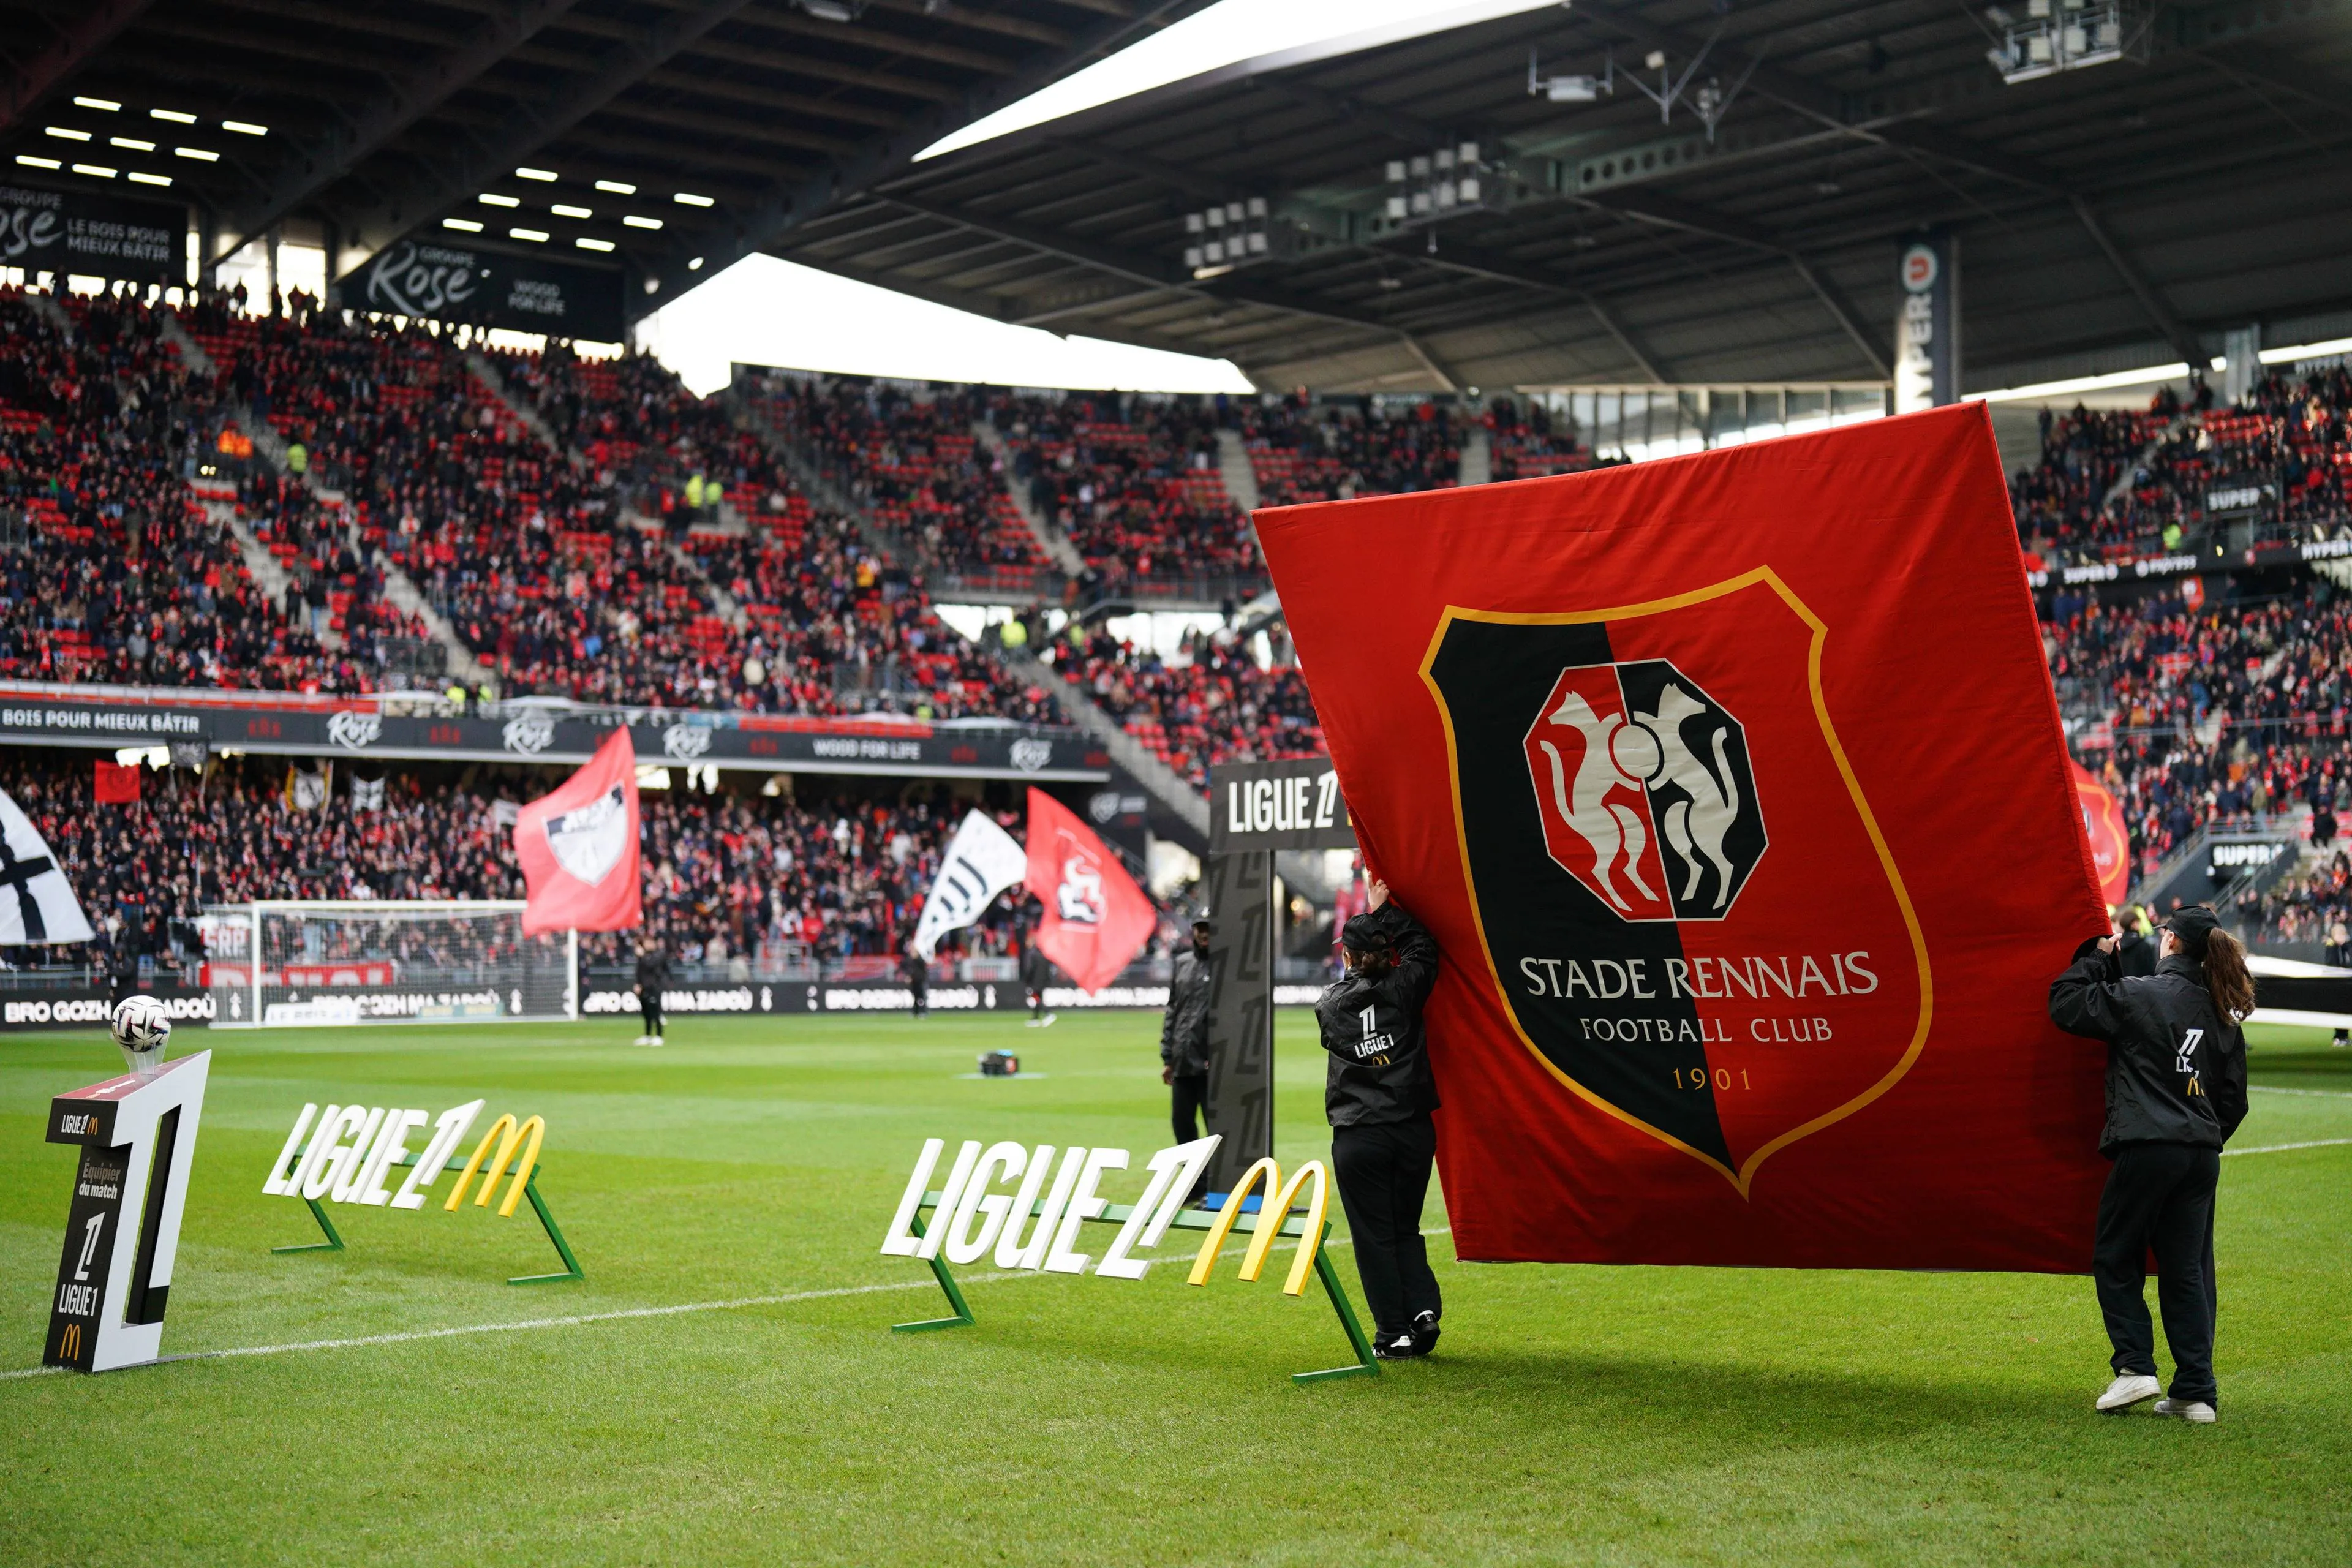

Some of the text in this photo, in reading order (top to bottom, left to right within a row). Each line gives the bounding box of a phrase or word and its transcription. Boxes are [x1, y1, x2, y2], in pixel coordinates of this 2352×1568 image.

[67, 218, 170, 244] LE BOIS POUR
[67, 235, 170, 263] MIEUX BÂTIR
[368, 241, 477, 317] Rose
[2209, 488, 2261, 511] SUPER
[2063, 564, 2106, 584] SUPER
[2, 709, 200, 733] BOIS POUR MIEUX BÂTIR
[812, 739, 921, 761] WOOD FOR LIFE
[1228, 776, 1311, 834] LIGUE
[2212, 844, 2270, 867] SUPER
[1520, 951, 1879, 1000] STADE RENNAIS
[4, 992, 216, 1023] BRO GOZH ADOÙ
[1579, 1017, 1833, 1042] FOOTBALL CLUB
[1672, 1067, 1752, 1091] 1901
[61, 1114, 83, 1134] LIGUE
[262, 1102, 429, 1207] LIGUE
[82, 1156, 121, 1186] Équipier
[78, 1182, 118, 1200] du match
[880, 1137, 1129, 1276] LIGUE
